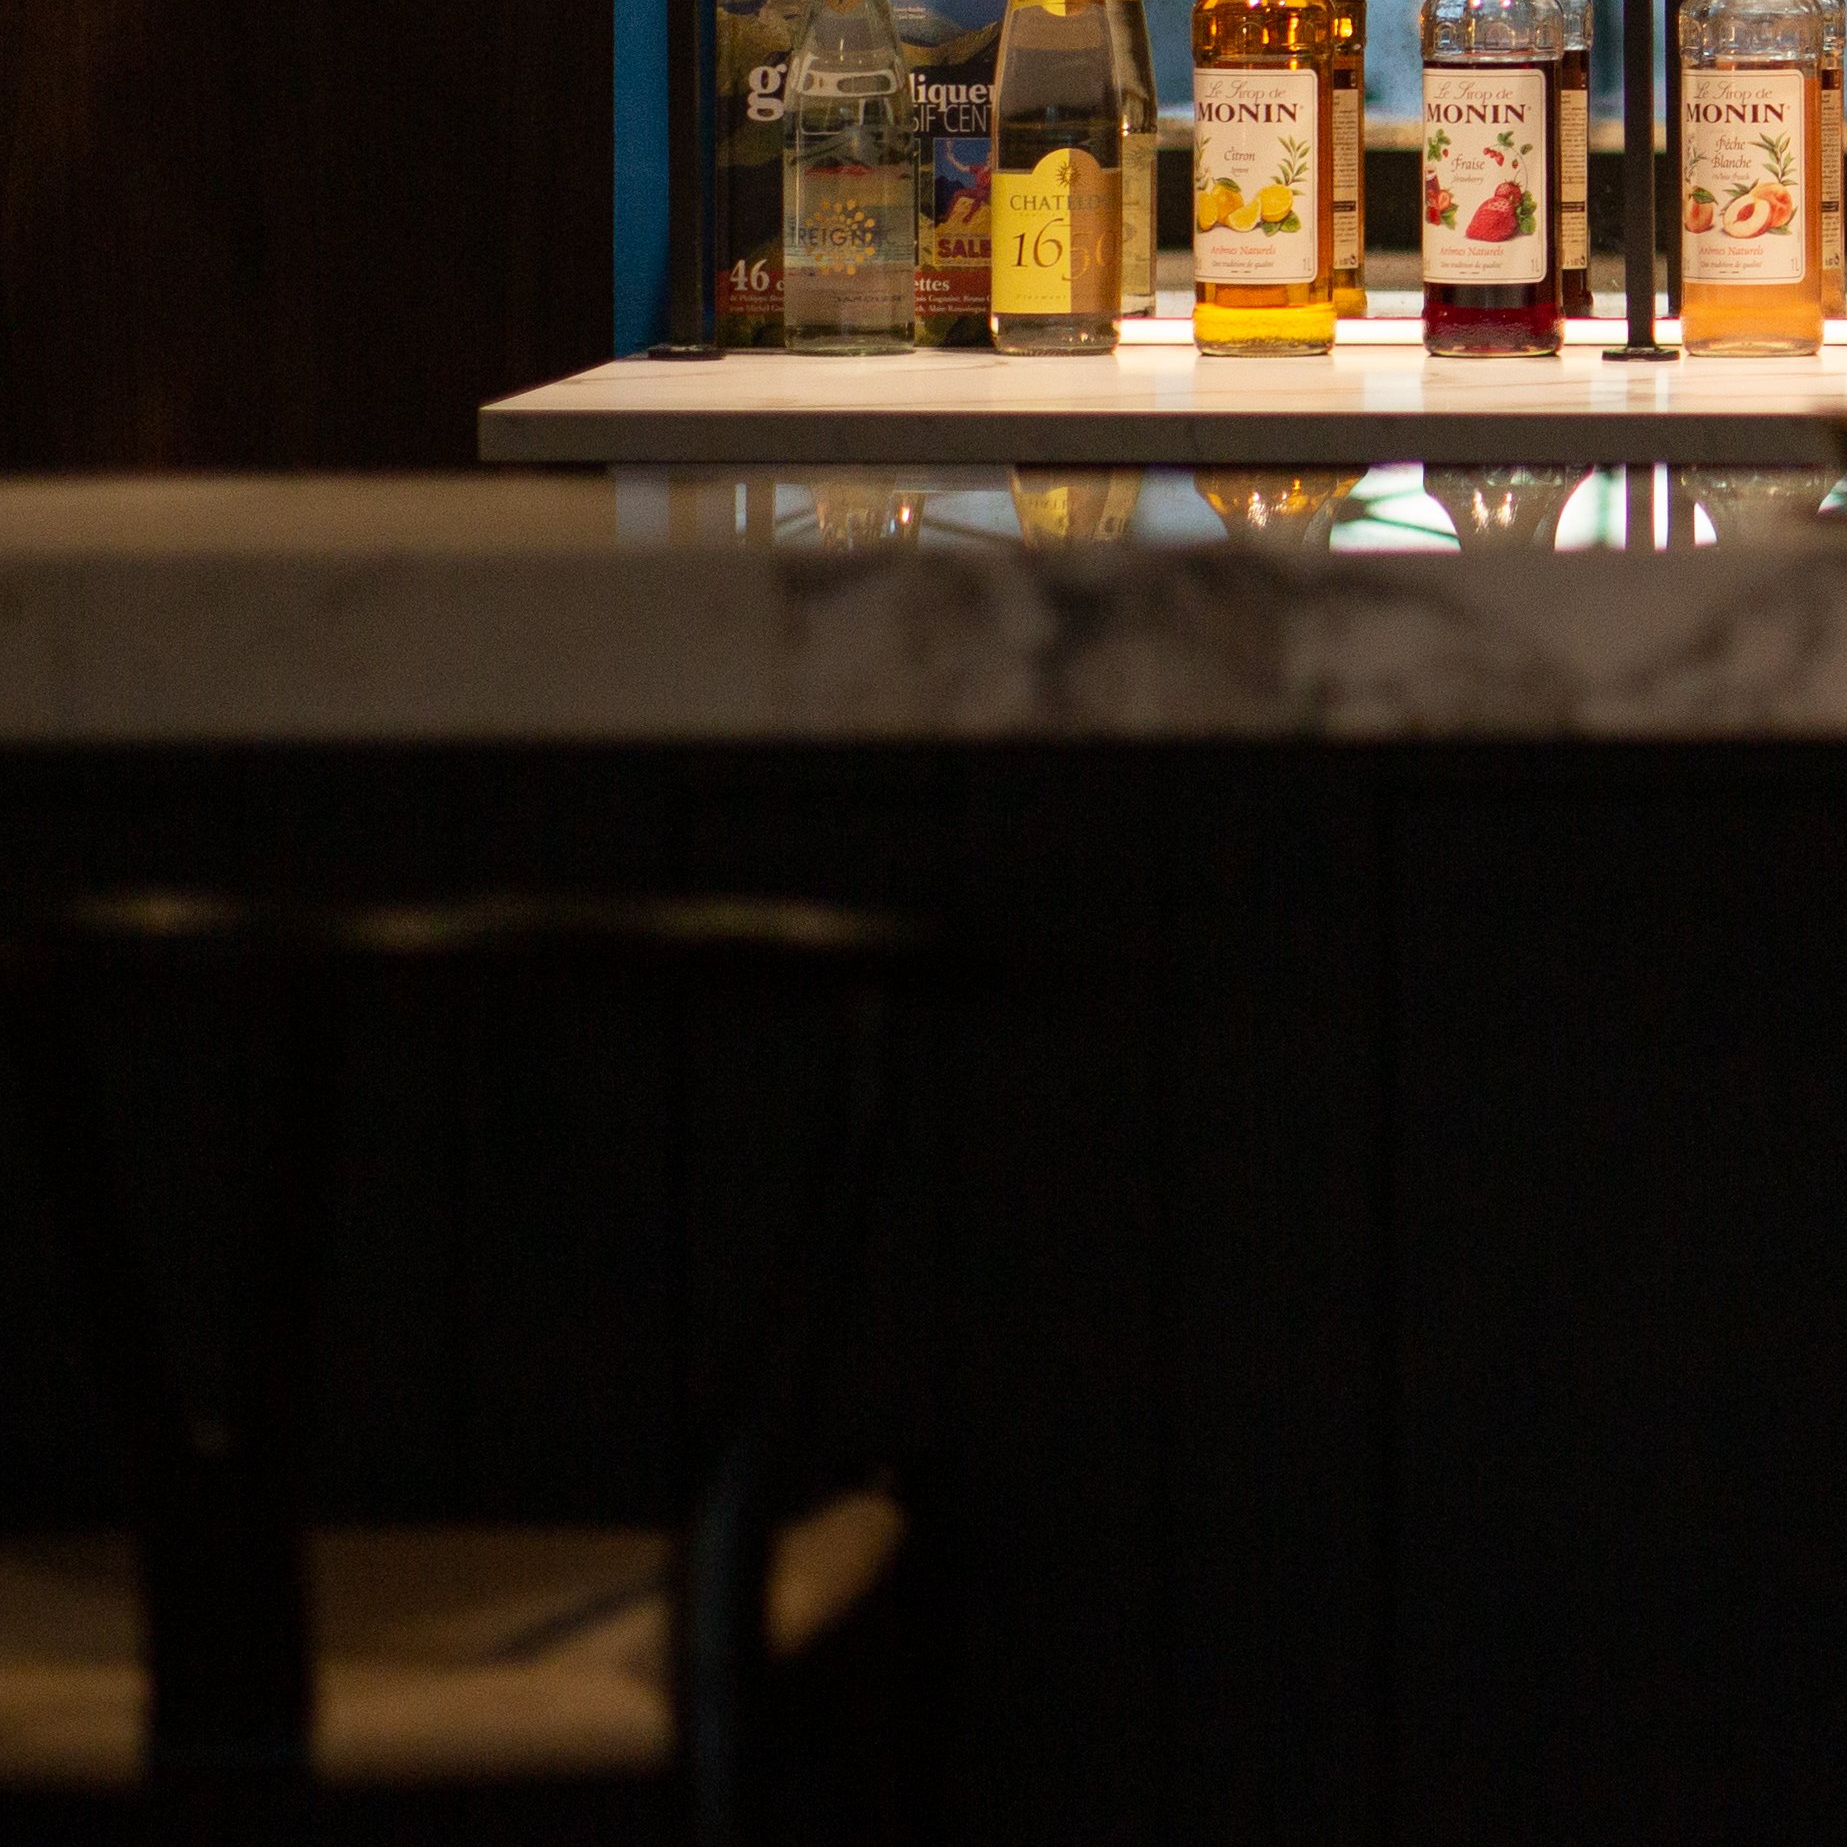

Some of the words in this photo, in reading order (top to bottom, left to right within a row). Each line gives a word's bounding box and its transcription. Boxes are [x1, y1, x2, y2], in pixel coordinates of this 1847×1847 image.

[1205, 79, 1224, 99] Le
[1225, 78, 1266, 105] Sirop
[1269, 87, 1287, 99] de
[1433, 81, 1452, 100] Le
[1453, 79, 1493, 105] Sirop
[1496, 87, 1514, 100] de
[1693, 82, 1712, 99] Le
[1713, 80, 1752, 105] Sirop
[1756, 87, 1773, 99] de
[1197, 102, 1299, 123] MONIN
[1425, 103, 1526, 124] MONIN
[1685, 103, 1785, 124] MONIN
[1714, 135, 1747, 152] Pêche
[1223, 145, 1256, 163] Citron
[1450, 153, 1486, 172] Fraise
[1711, 155, 1753, 170] Blanche
[1239, 245, 1276, 255] Naturels
[1467, 246, 1505, 257] Naturels
[1727, 246, 1764, 256] Naturels
[728, 258, 771, 292] 46
